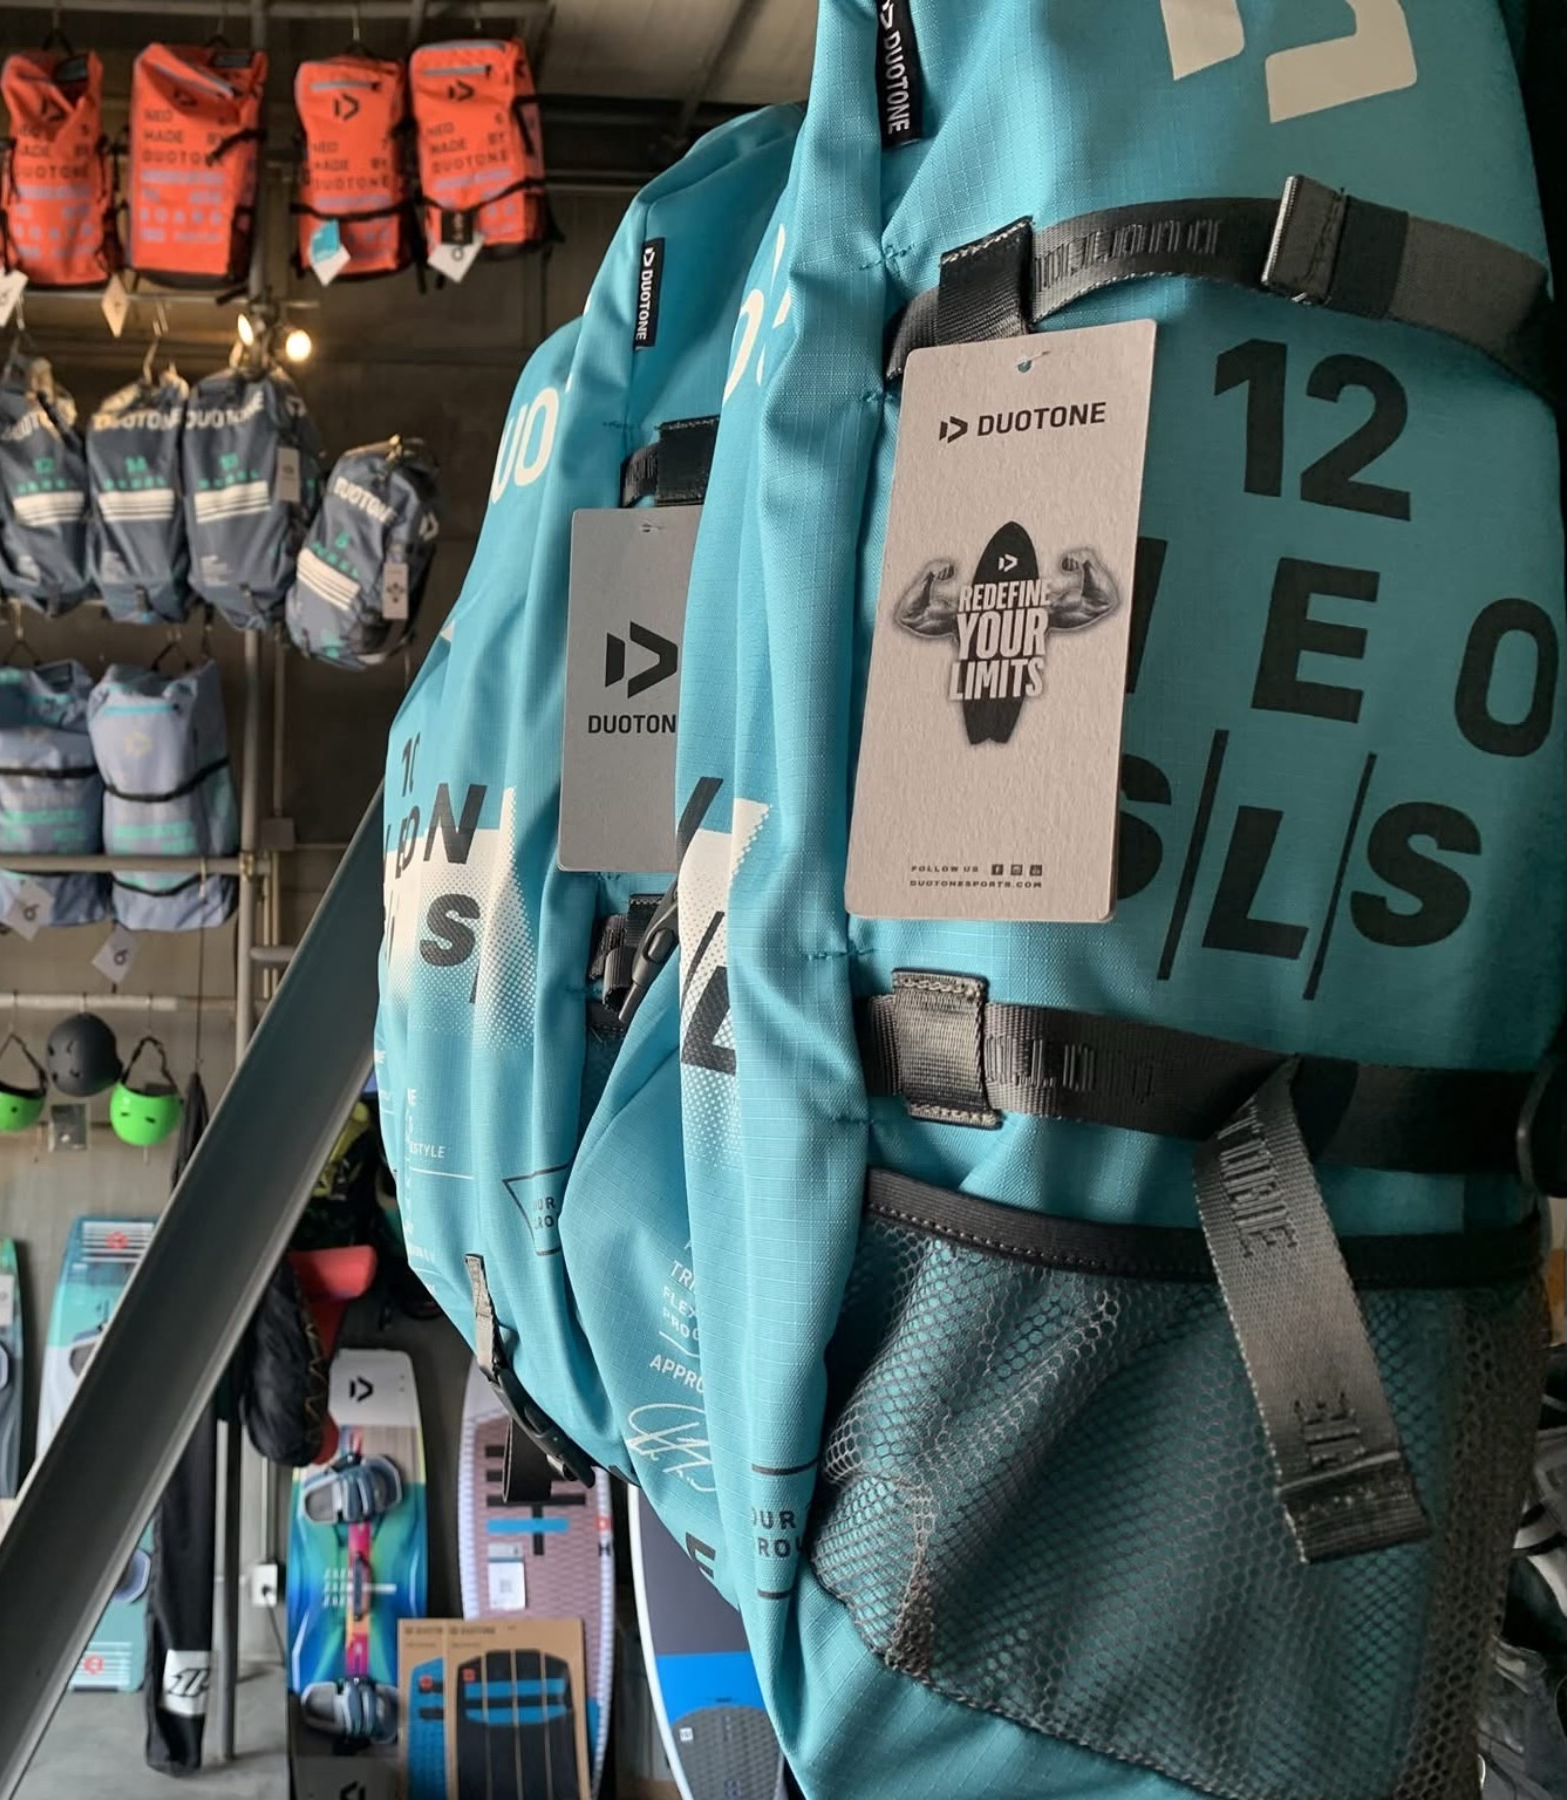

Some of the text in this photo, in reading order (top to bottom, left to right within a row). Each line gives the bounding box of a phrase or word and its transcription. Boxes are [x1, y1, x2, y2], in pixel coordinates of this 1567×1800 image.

[882, 32, 911, 135] DUOTONE
[635, 268, 654, 342] DUOTONE
[977, 401, 1107, 437] DUOTONE
[1213, 337, 1412, 523] 12
[958, 578, 1052, 613] REDEFINE
[956, 606, 1050, 661] YOUR
[948, 656, 1045, 701] LIMITS
[588, 714, 677, 735] DUOTON
[909, 879, 1043, 889] DUOTONESPORTS.COM
[910, 864, 980, 873] FOLLOW US
